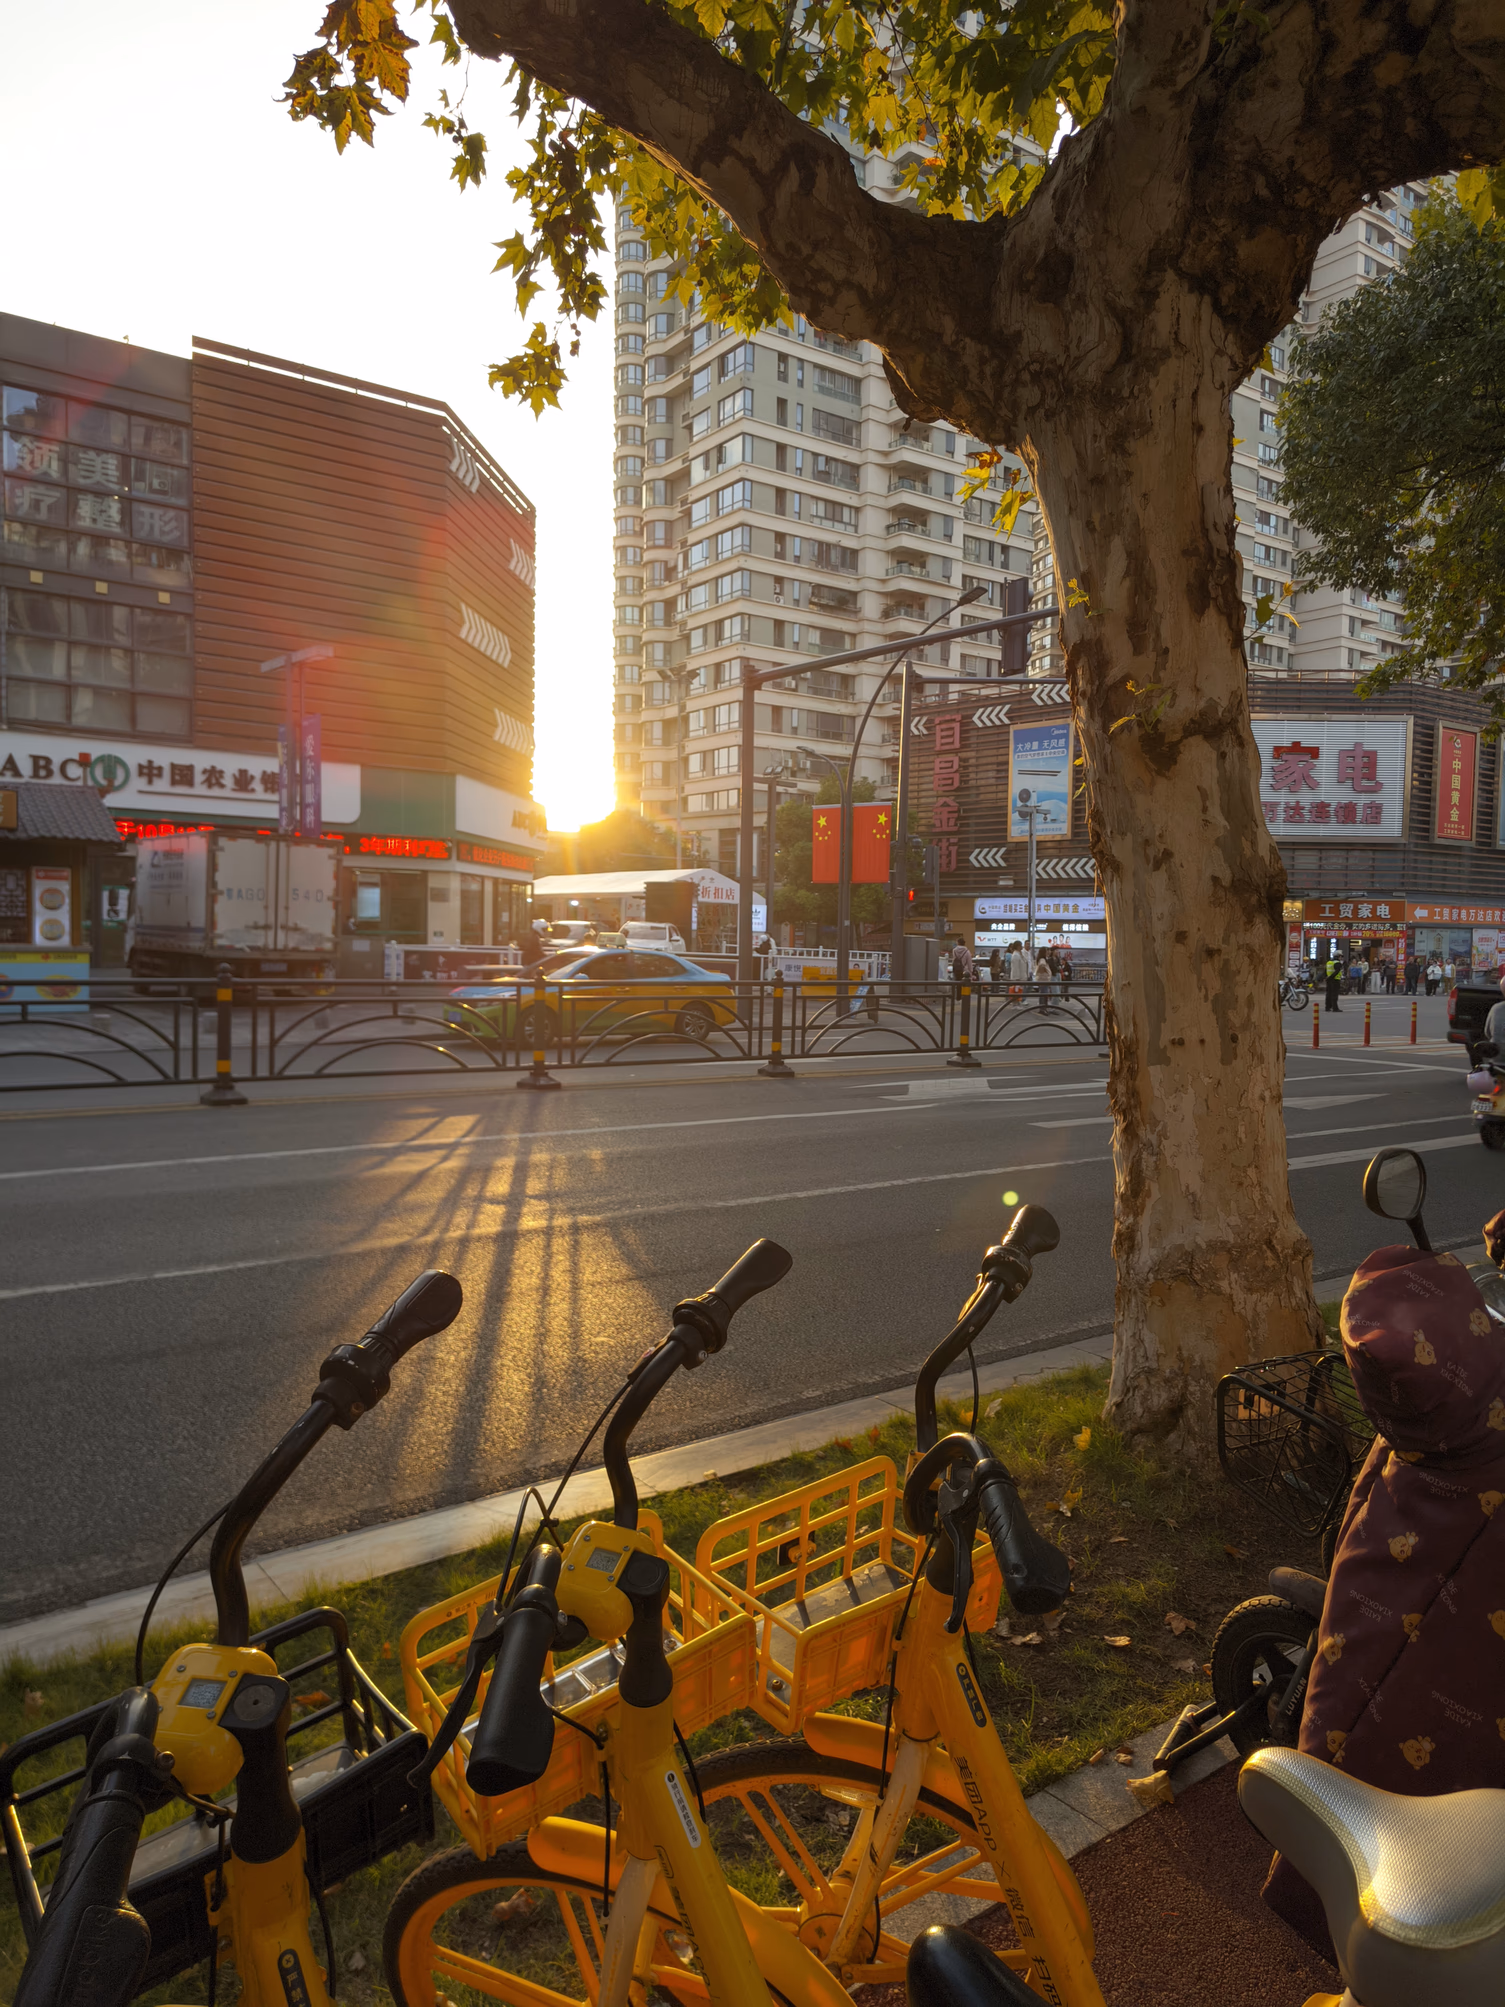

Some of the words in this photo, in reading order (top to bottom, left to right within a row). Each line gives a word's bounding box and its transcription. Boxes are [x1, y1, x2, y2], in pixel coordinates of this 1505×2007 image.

[137, 759, 281, 795] 中国农业银
[1271, 741, 1384, 793] 家电
[932, 714, 962, 873] 宜昌金街
[1450, 758, 1462, 822] 中国黄金
[1261, 800, 1384, 825] 万达连锁店
[701, 885, 736, 901] 折扣店
[1044, 903, 1080, 914] 中国黄金
[1319, 903, 1393, 919] 工贸家电
[1350, 1589, 1393, 1618] XIAOXIONG
[1285, 1677, 1307, 1716] LUYUAN
[1005, 1887, 1036, 1939] 微信
[285, 1970, 306, 2007] 严禁
